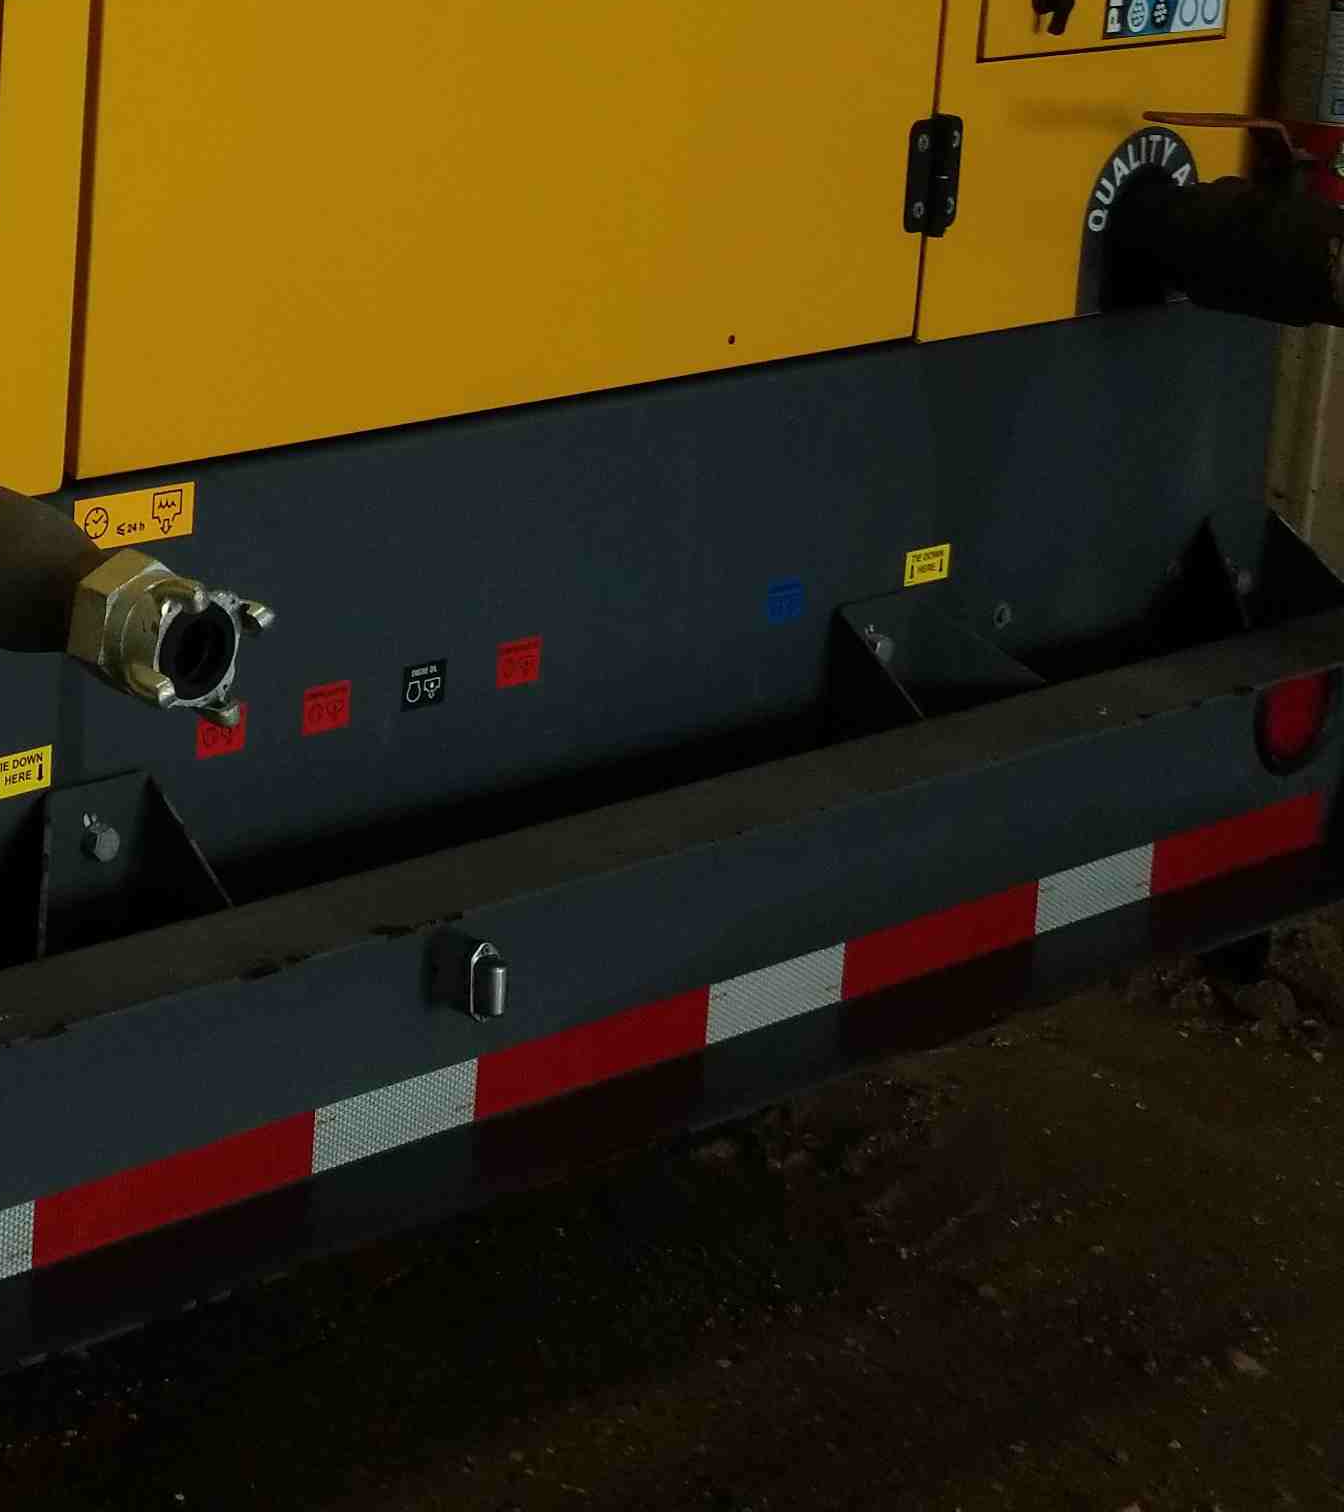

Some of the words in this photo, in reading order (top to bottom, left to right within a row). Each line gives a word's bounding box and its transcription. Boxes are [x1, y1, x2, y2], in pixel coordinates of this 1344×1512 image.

[1087, 134, 1178, 233] QUALITY
[11, 752, 44, 770] DOWN
[4, 769, 33, 786] HERE
